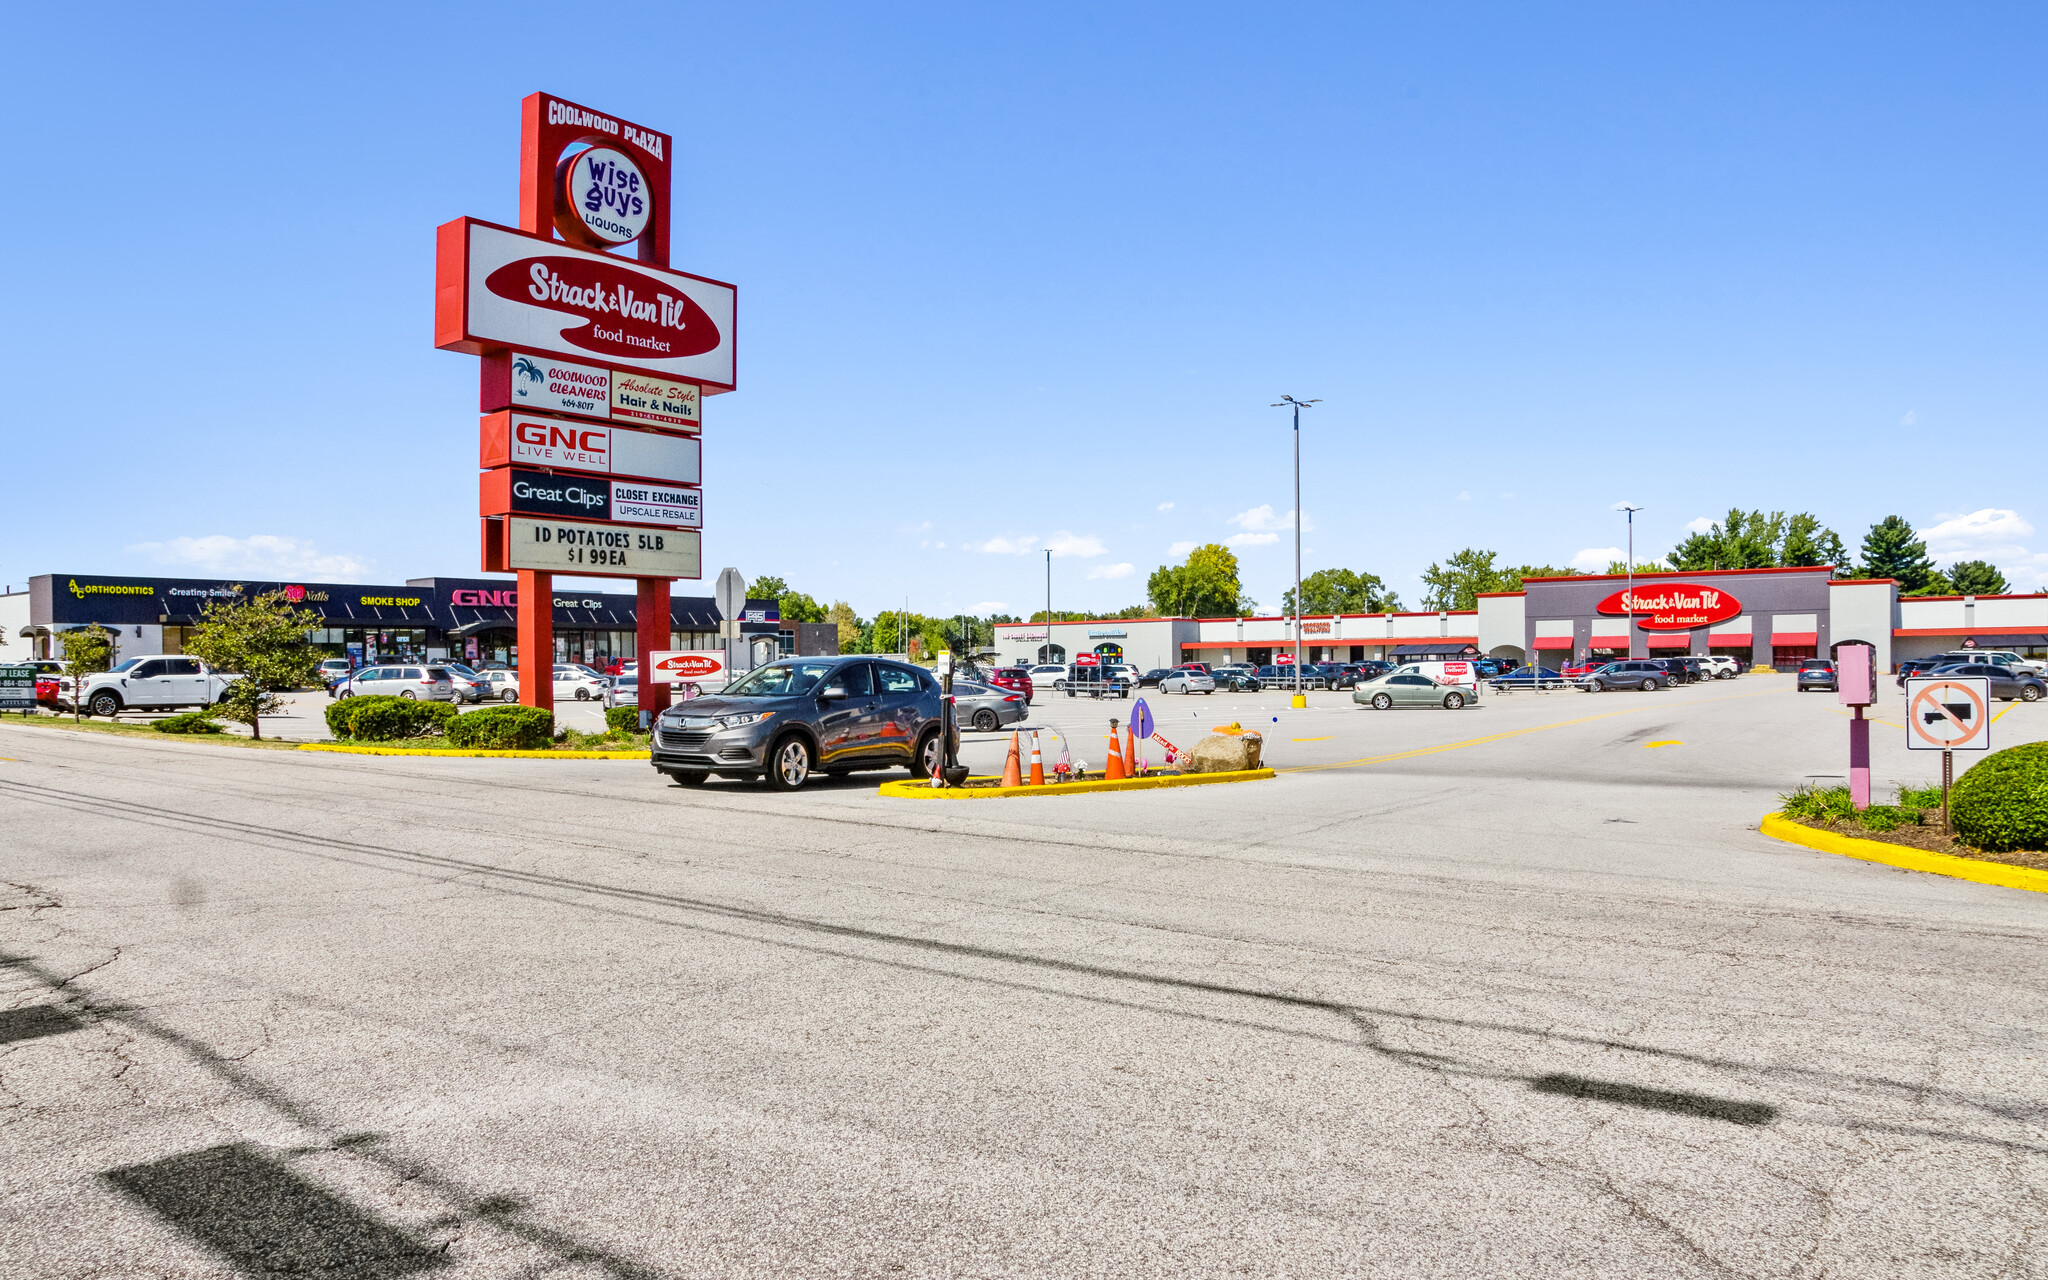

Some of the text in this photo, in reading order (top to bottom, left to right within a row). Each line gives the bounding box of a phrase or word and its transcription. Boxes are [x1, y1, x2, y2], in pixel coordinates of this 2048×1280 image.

[548, 100, 664, 162] COOLWOOD PLAZA
[585, 181, 643, 218] guys
[585, 213, 633, 239] LIQUORS
[528, 262, 610, 313] Strack
[617, 284, 658, 323] Van
[656, 293, 686, 331] Til
[593, 324, 671, 353] food market
[548, 367, 608, 388] COOLWOOD
[549, 382, 607, 401] CLEANERS
[617, 378, 696, 403] Absolute Style
[619, 393, 692, 416] Hair & Nails
[516, 422, 606, 454] GNC
[517, 445, 606, 465] LIVE WELL
[513, 481, 604, 509] Great Clips
[615, 488, 699, 506] CLOSET EXCHANGE
[619, 505, 695, 520] UPSCALE RESALE
[557, 528, 630, 548] POTATOES
[84, 585, 154, 595] ORTHODONTICS
[171, 587, 207, 598] Creating
[303, 590, 329, 602] Nails
[452, 589, 517, 607] GNC
[360, 596, 421, 606] SMOKE SHOP
[553, 598, 602, 610] Great Clips
[1621, 592, 1669, 611] Strack
[1673, 592, 1701, 609] Van
[1700, 591, 1720, 609] Til
[1654, 614, 1708, 623] food market
[9, 669, 30, 678] LEASE
[667, 660, 690, 669] Strack
[691, 660, 704, 668] Van
[703, 659, 712, 668] Til
